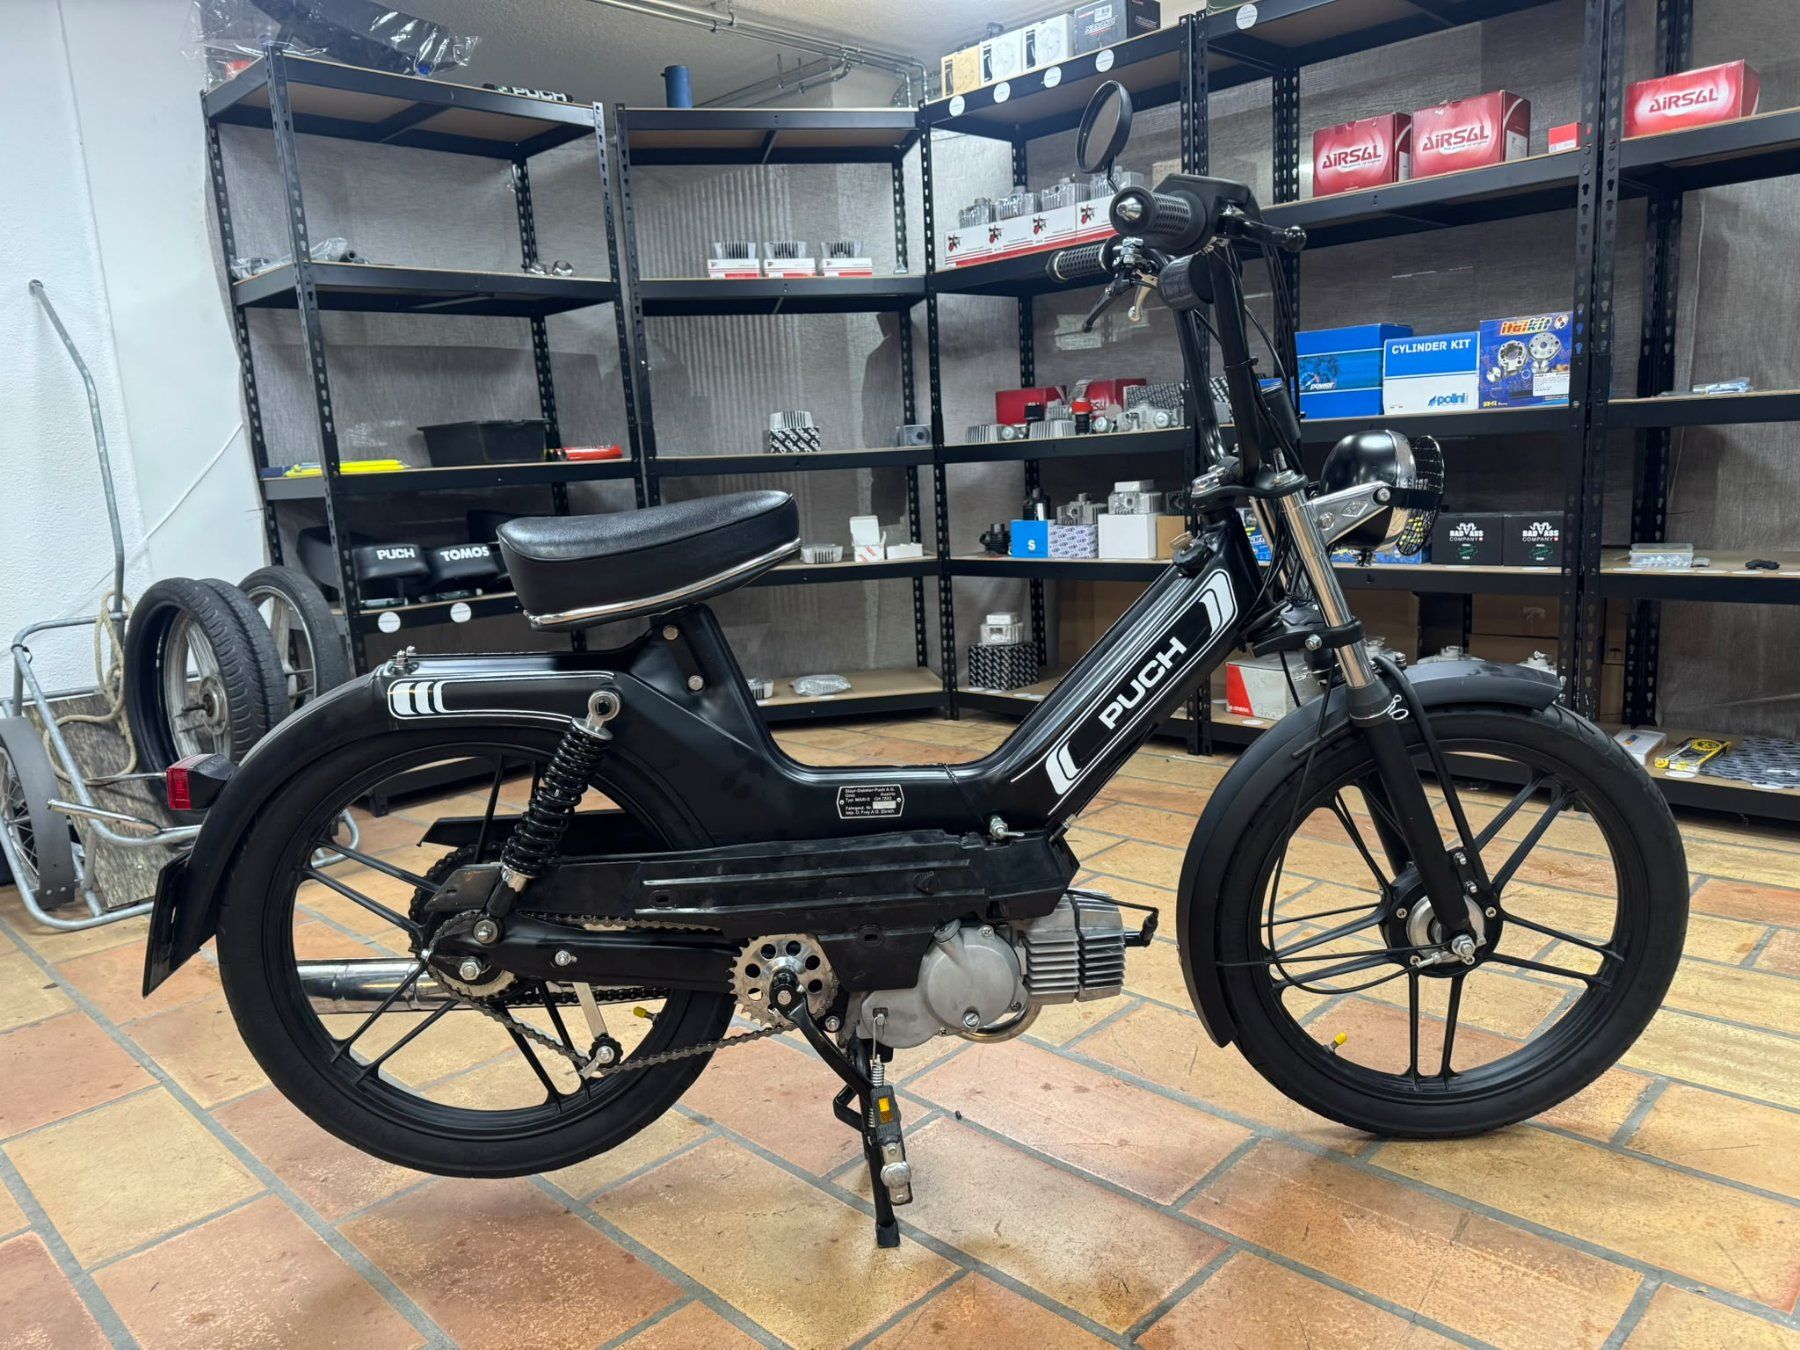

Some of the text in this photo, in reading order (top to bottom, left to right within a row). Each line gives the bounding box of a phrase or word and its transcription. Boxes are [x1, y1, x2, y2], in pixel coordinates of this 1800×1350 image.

[1392, 338, 1471, 354] CYLINDER KIT
[1028, 539, 1036, 551] S
[376, 548, 415, 560] PUCH
[440, 546, 490, 562] TOMOS
[1098, 636, 1187, 730] PUCH
